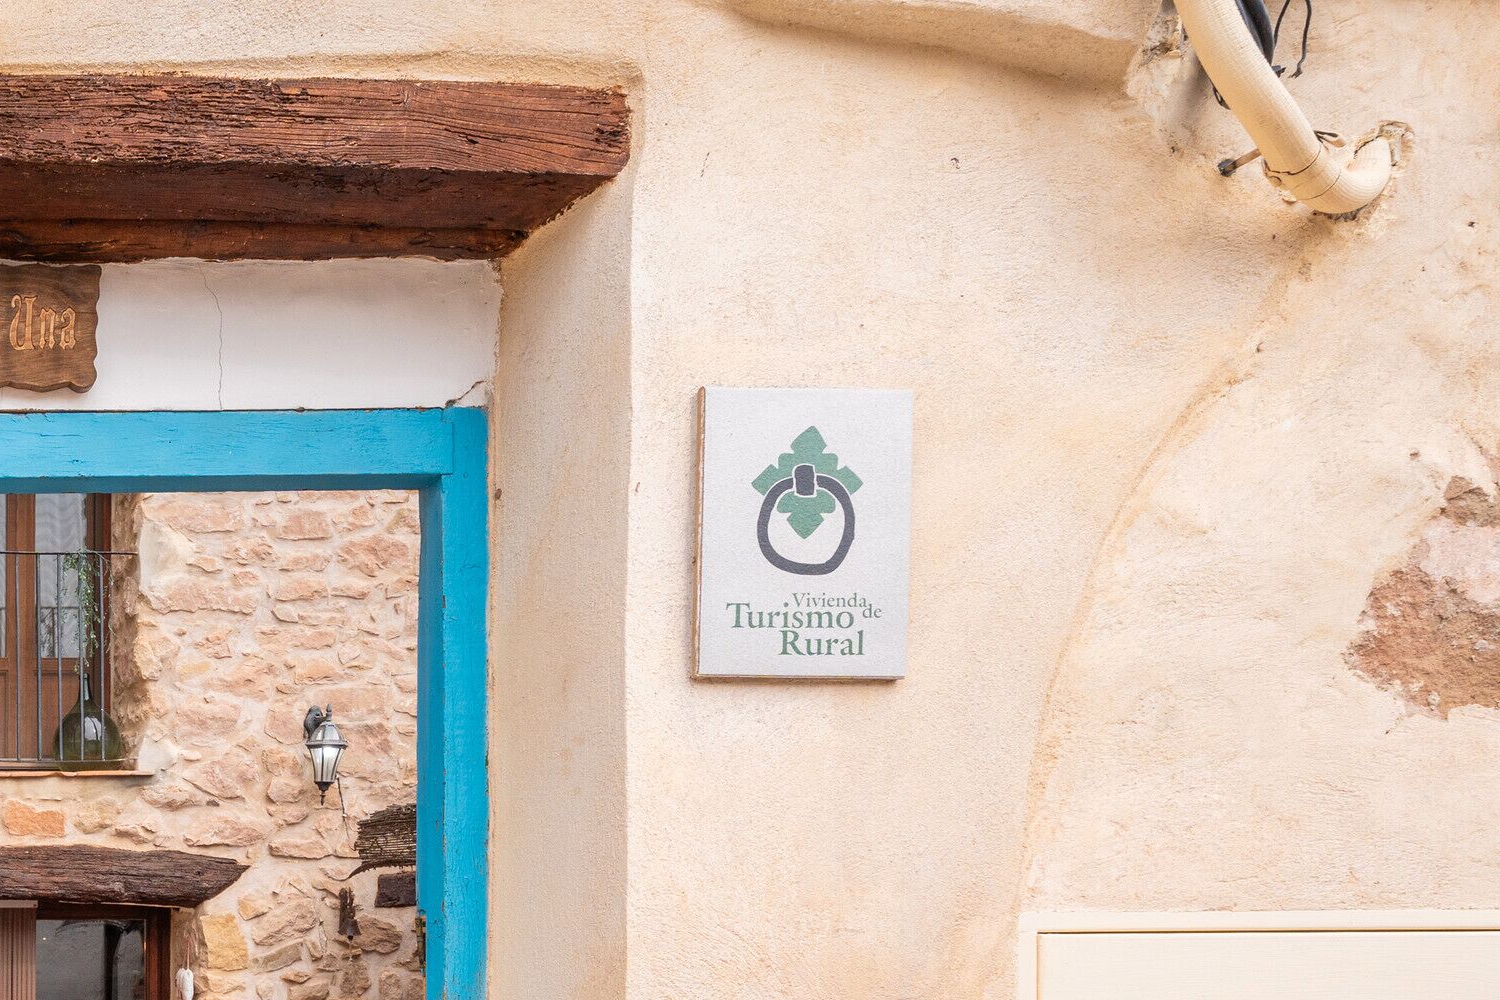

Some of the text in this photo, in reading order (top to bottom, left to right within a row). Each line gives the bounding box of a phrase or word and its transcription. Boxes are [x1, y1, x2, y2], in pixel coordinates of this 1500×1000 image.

[9, 293, 77, 351] Una
[725, 601, 855, 629] Turismo
[791, 592, 883, 619] Vivienda de
[778, 629, 866, 656] Rural
